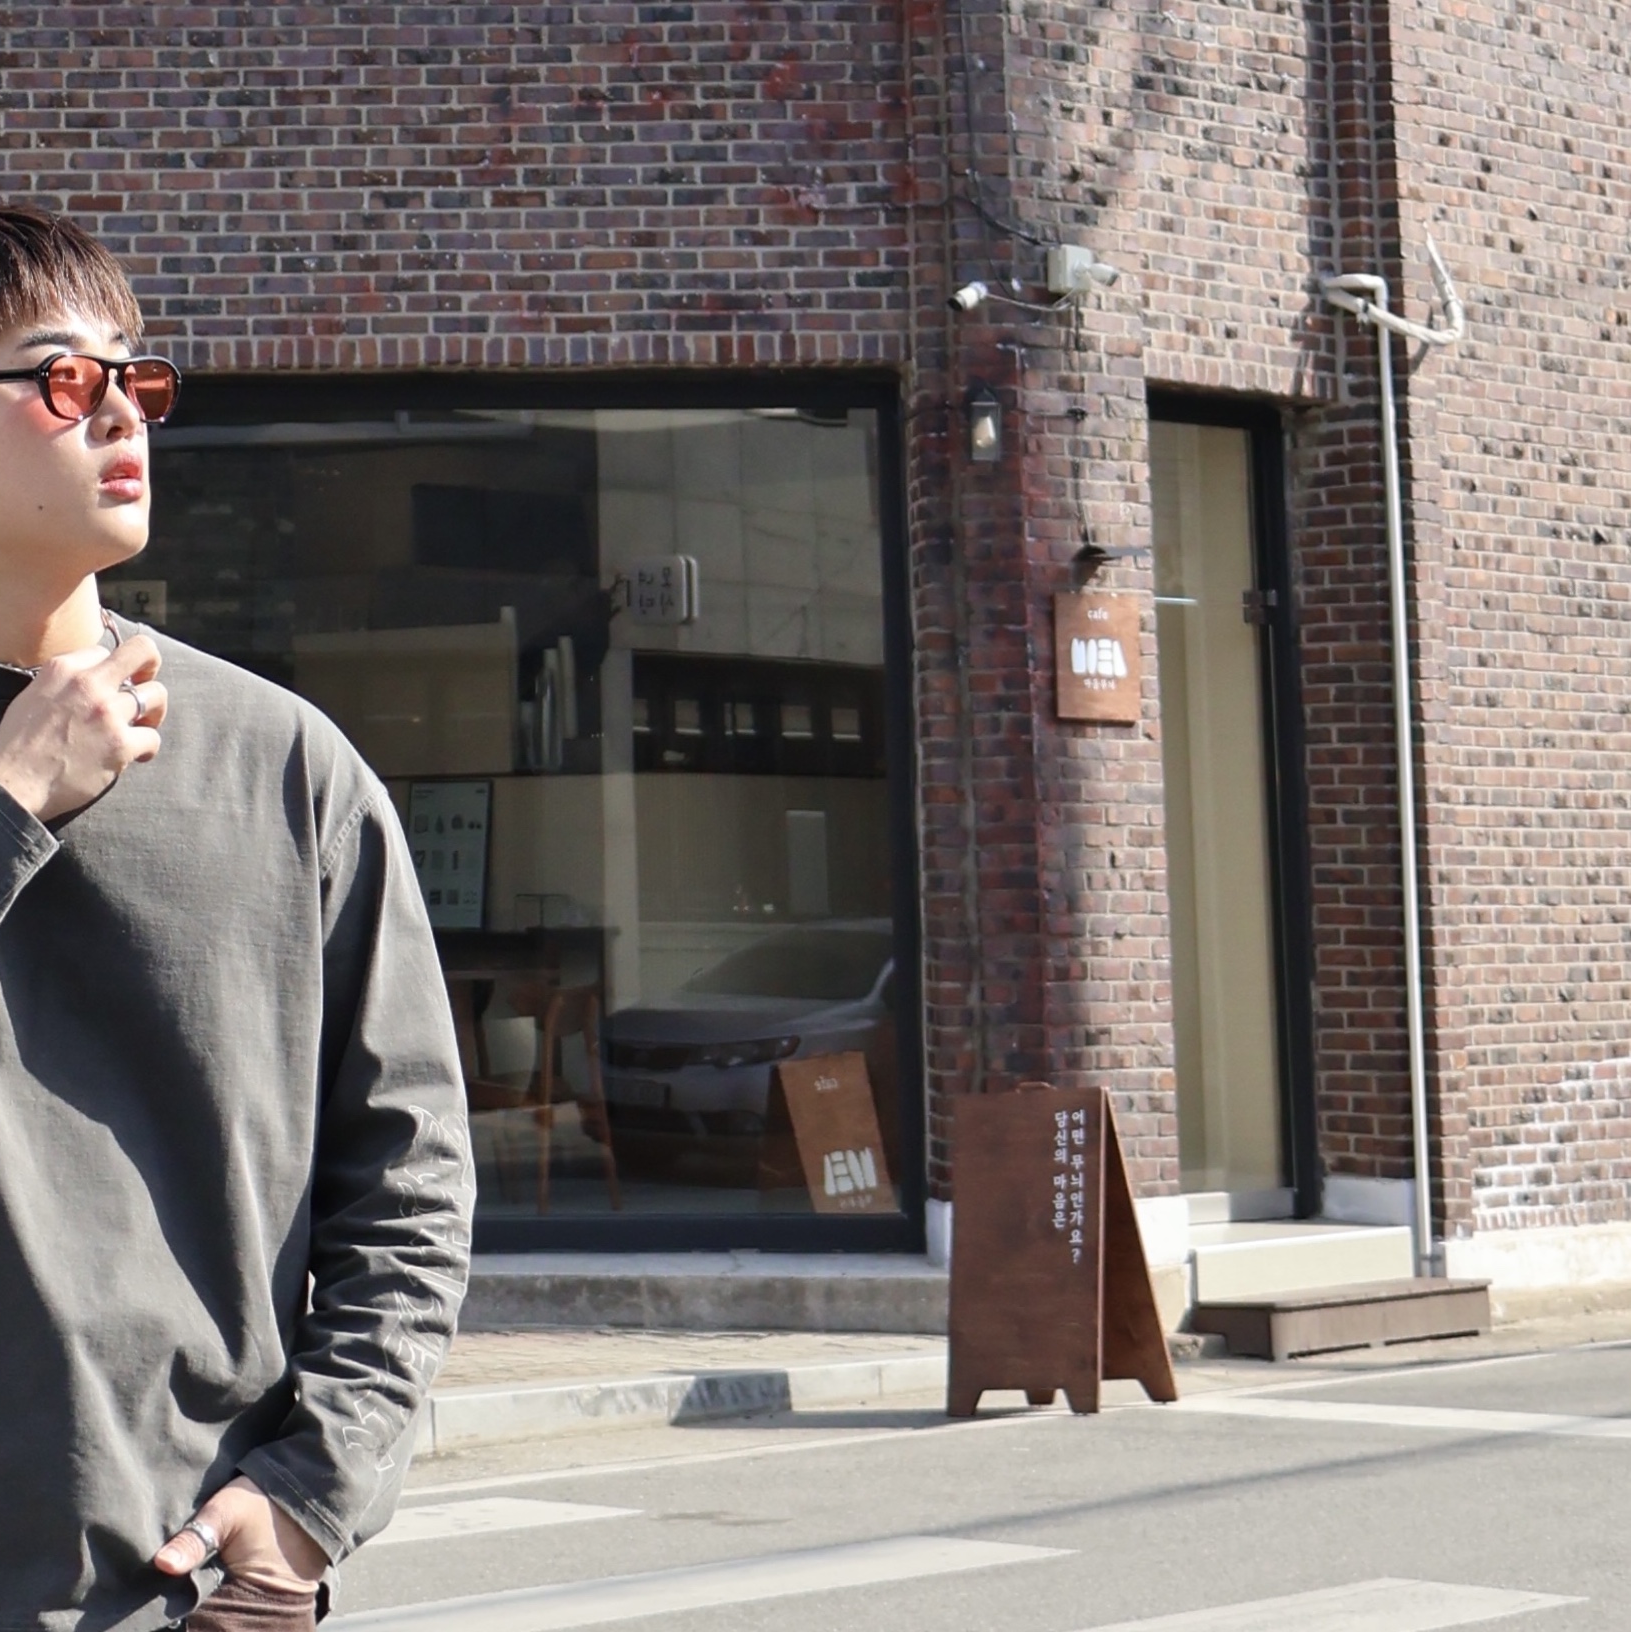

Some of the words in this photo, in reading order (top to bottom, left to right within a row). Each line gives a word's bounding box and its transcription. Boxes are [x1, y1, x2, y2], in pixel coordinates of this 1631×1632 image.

[1087, 607, 1108, 620] cafe
[1053, 1111, 1068, 1164] 당신의
[1071, 1109, 1085, 1145] 어떤
[1052, 1174, 1067, 1229] 마음은
[1069, 1154, 1085, 1264] 무늬인가요?
